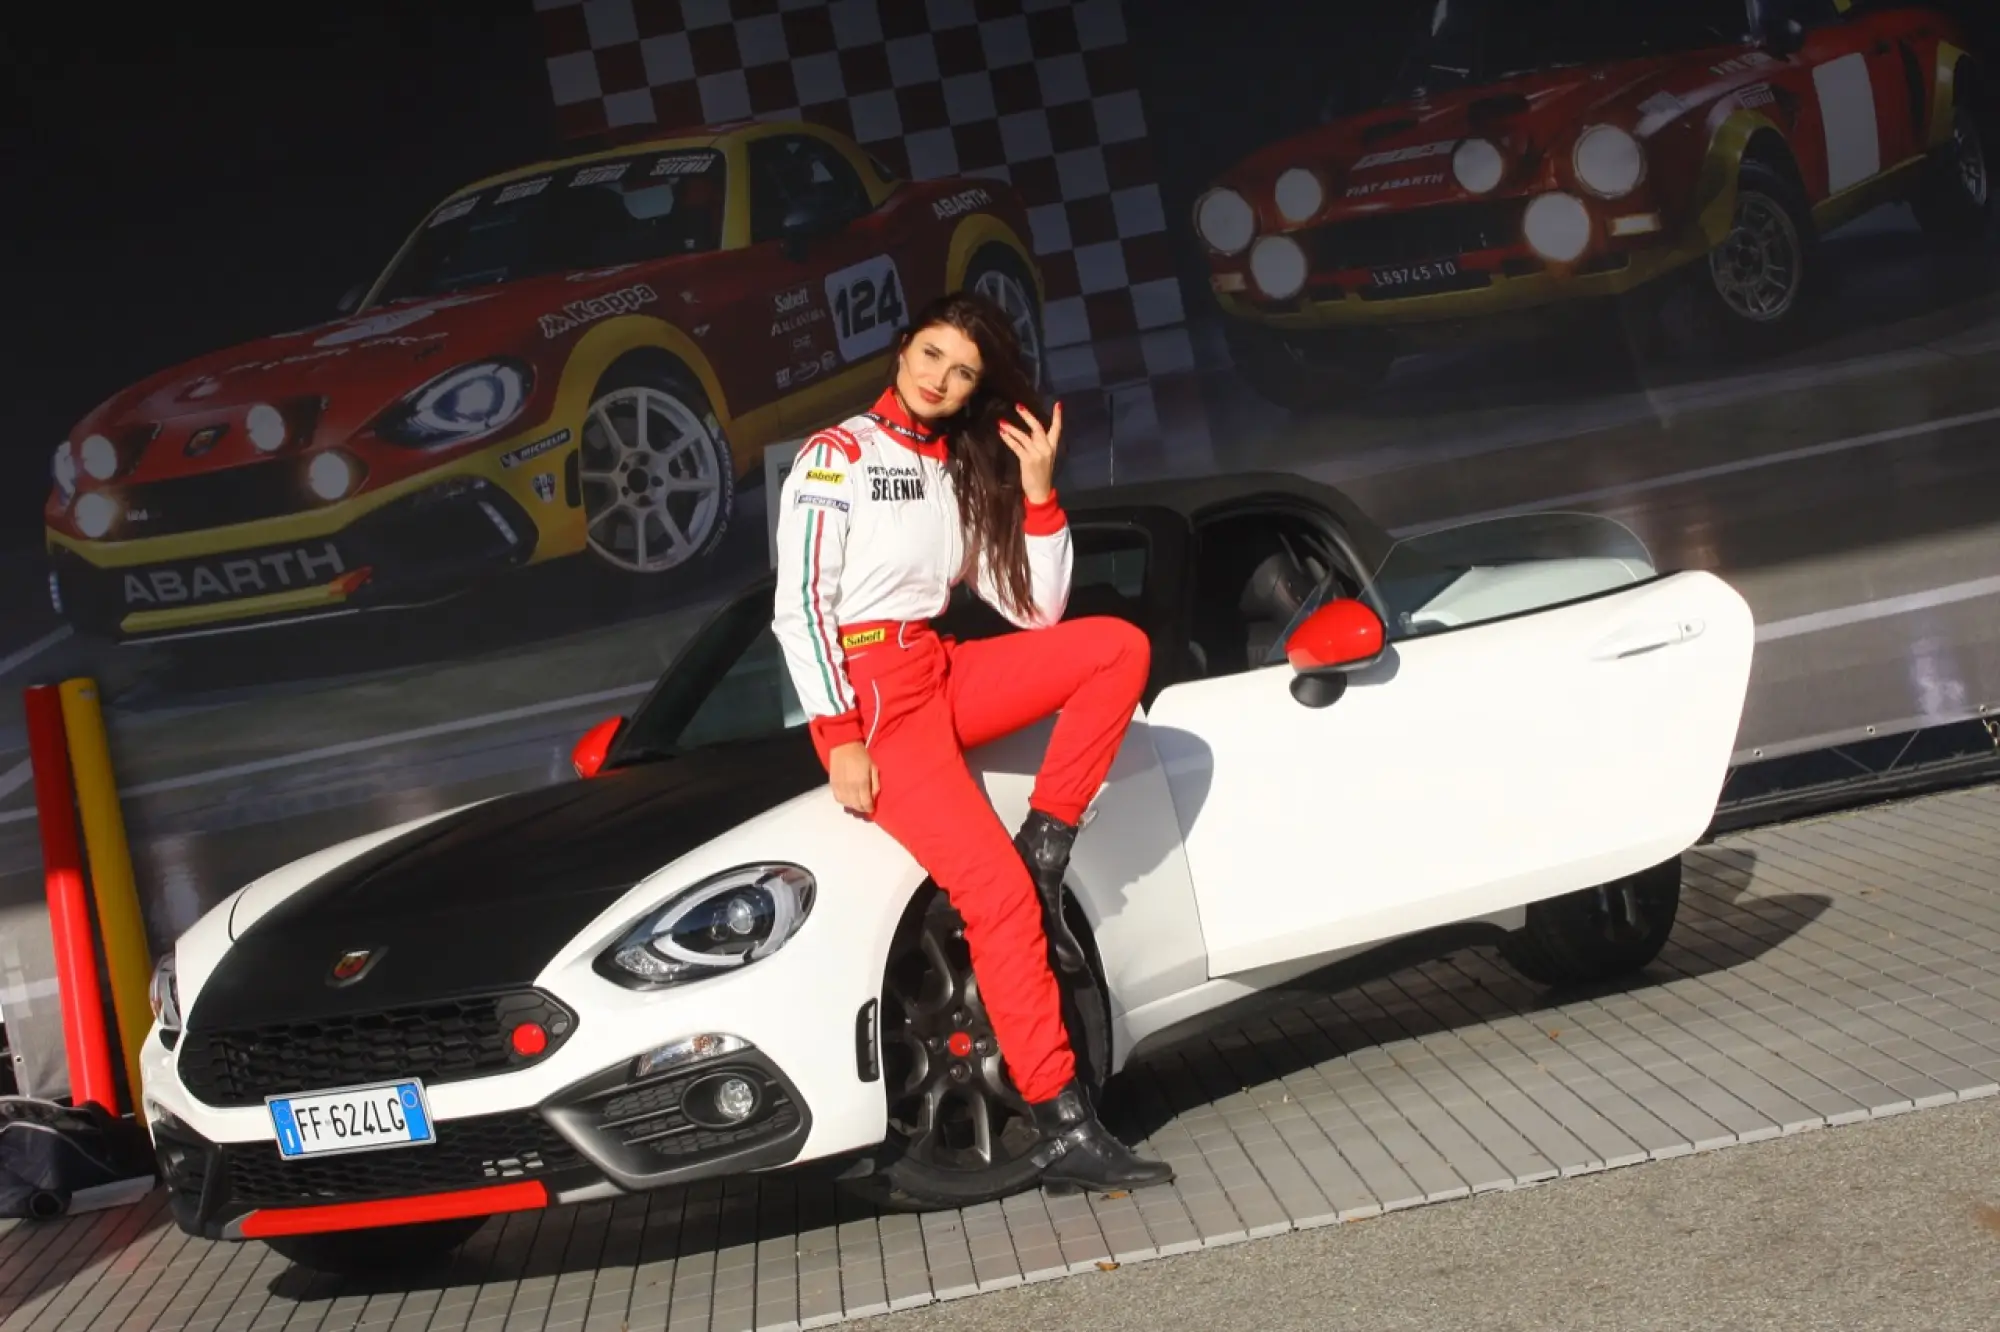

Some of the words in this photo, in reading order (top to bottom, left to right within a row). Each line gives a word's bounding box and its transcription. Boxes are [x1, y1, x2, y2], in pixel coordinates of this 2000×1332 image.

[1345, 183, 1380, 198] FIAT
[1381, 173, 1445, 191] ABARTH
[931, 188, 994, 221] ABARTH
[562, 283, 658, 324] Kappa
[834, 271, 904, 340] 124
[520, 430, 569, 459] MICHELIN
[124, 542, 346, 604] ABARTH
[846, 629, 882, 647] Sabelt
[294, 1106, 323, 1142] FF
[330, 1098, 405, 1138] 624LG
